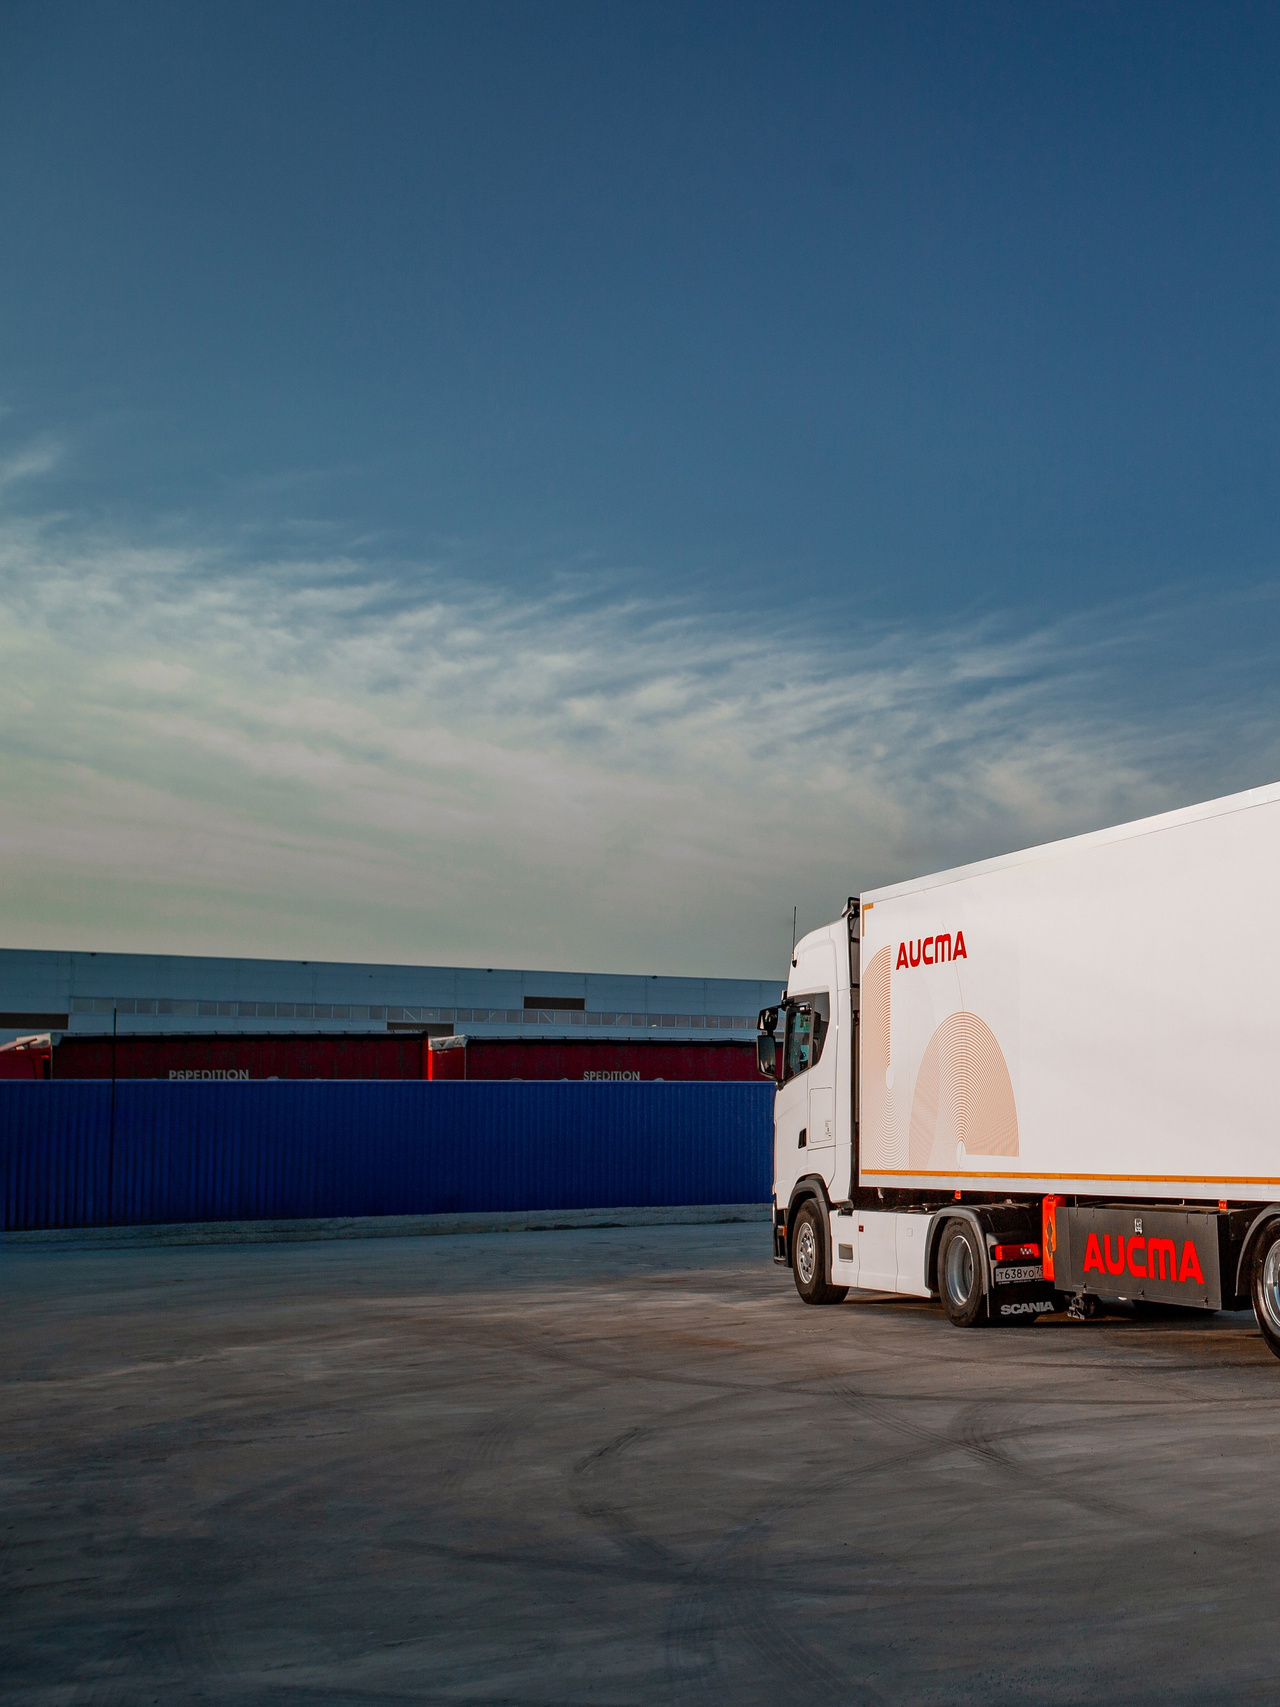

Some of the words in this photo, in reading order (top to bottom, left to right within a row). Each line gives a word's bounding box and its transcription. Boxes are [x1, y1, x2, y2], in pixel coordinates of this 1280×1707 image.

[896, 931, 967, 970] AUCMA
[583, 1070, 641, 1081] SPEDITION
[1083, 1233, 1204, 1286] AUCMA
[1000, 1301, 1055, 1316] SCANIA
